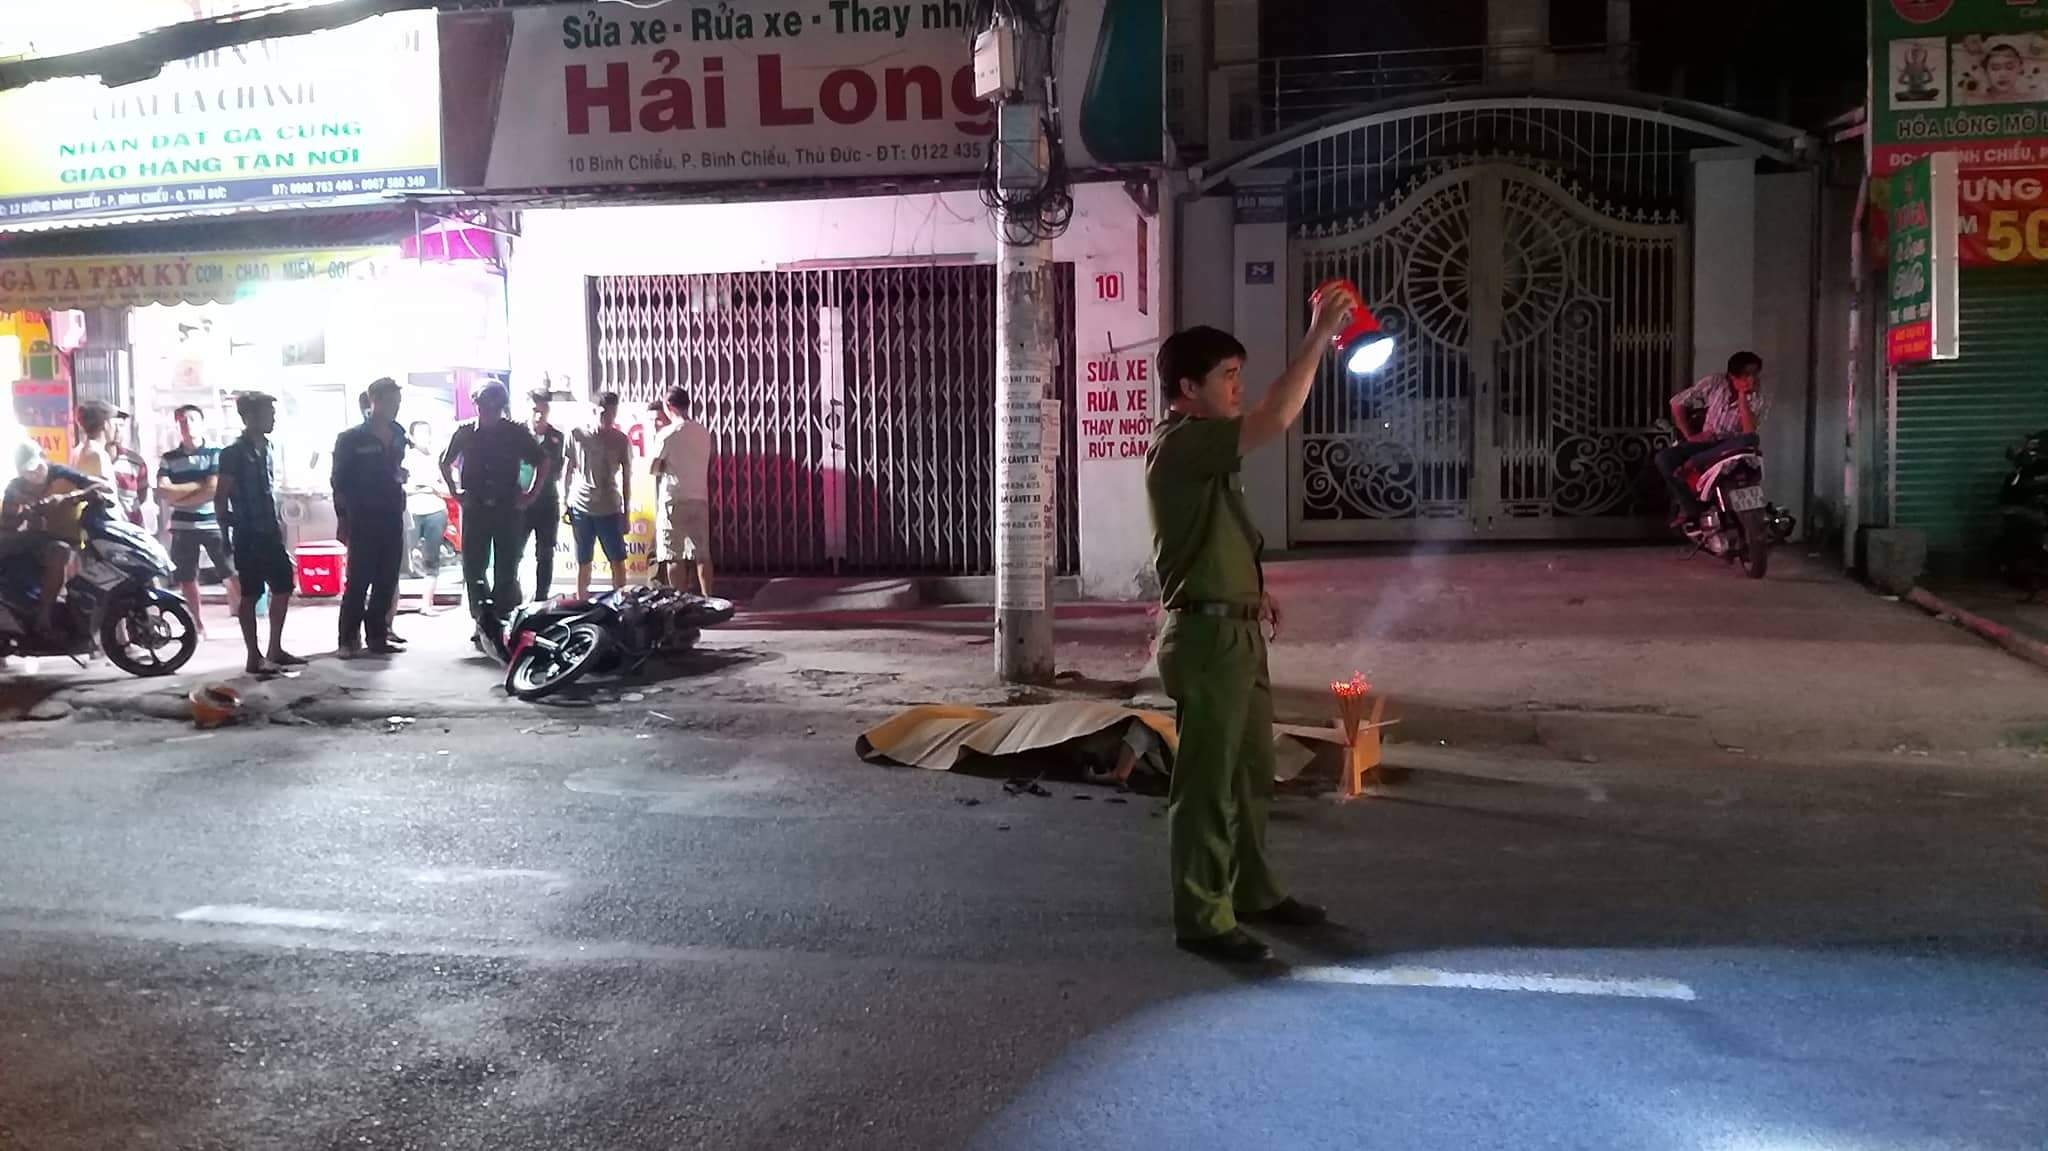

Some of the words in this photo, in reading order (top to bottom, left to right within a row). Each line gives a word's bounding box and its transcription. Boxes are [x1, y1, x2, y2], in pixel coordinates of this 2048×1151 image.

[563, 10, 621, 49] Sửa
[631, 17, 666, 45] xe
[692, 2, 753, 40] Rửa
[764, 10, 802, 37] xe
[829, 0, 910, 38] Thay
[565, 49, 727, 135] Hải
[757, 53, 995, 136] Long
[568, 156, 585, 172] 10
[589, 153, 624, 172] Bình
[682, 153, 697, 169] P.
[702, 150, 736, 168] Bình
[796, 144, 825, 164] Thủ
[829, 143, 861, 163] Đức
[911, 143, 948, 160] 0122
[955, 142, 981, 159] 435
[60, 164, 127, 184] GIAO
[45, 267, 81, 290] TA
[1096, 274, 1119, 299] 10
[1087, 354, 1119, 382] SỬA
[1127, 359, 1147, 381] XE
[1087, 385, 1119, 412] RỬA
[1127, 389, 1147, 411] XE
[1082, 419, 1114, 436] THAY
[1088, 436, 1115, 458] RÚT
